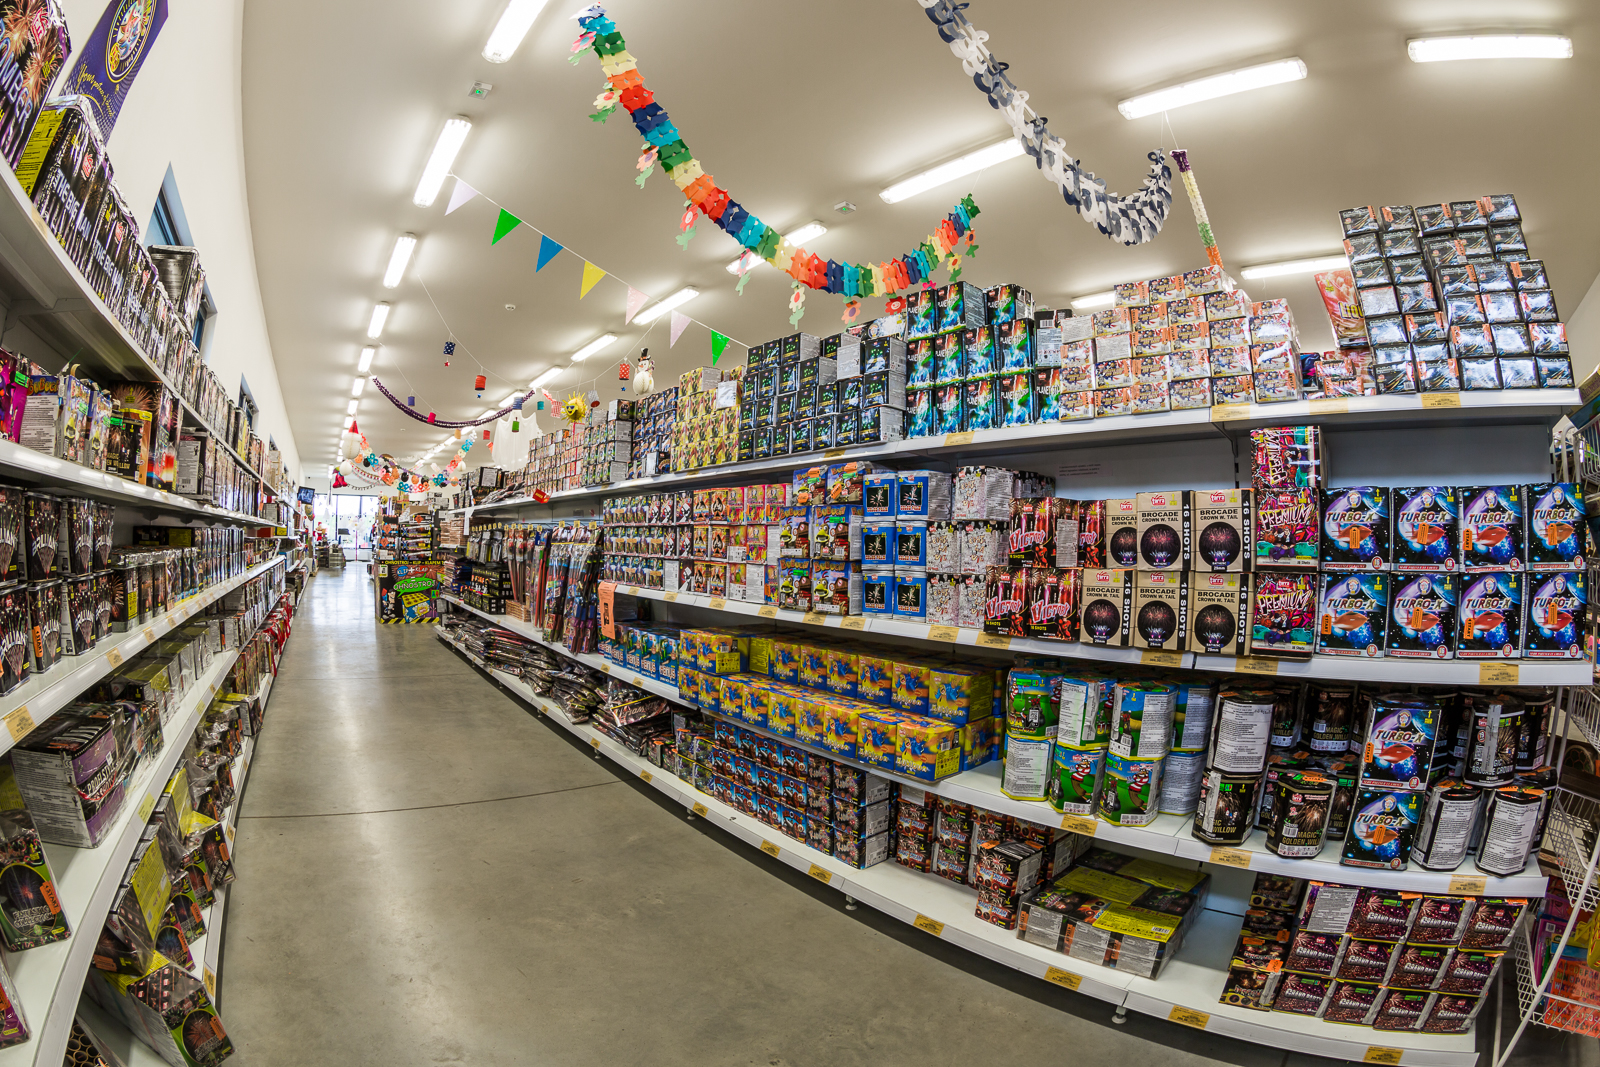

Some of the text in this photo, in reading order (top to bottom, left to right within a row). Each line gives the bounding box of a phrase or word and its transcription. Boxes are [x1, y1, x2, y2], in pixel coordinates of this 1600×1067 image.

[1000, 391, 1014, 399] PLANET
[1265, 428, 1287, 485] PREMIUM
[1183, 504, 1190, 517] 16
[1243, 501, 1250, 515] 16
[1534, 508, 1577, 520] TURBO-X
[1260, 503, 1314, 531] PREMIUM
[1326, 511, 1375, 522] TURBO-X
[1400, 511, 1448, 522] TURBO-X
[1468, 511, 1514, 524] TURBO-X
[1009, 528, 1046, 552] VICTORY
[985, 596, 1022, 618] VICTORY
[1122, 582, 1132, 635] 16 SHOTS
[1257, 590, 1312, 615] PREMIUM
[1327, 598, 1376, 609] TURBO-X
[1395, 598, 1446, 609] TURBO-X
[1465, 597, 1512, 609] TURBO-X
[1534, 597, 1577, 608] TURBO-X
[1031, 599, 1070, 623] VICTORY
[1178, 582, 1188, 638] 16 SHOTS
[1237, 586, 1247, 643] 16 SHOTS
[1375, 729, 1425, 743] TURBO-X
[1356, 813, 1407, 827] TURBO-X
[1213, 826, 1237, 834] WILLOW
[1282, 837, 1306, 845] GOLDEN
[979, 867, 1008, 885] MAGIC DREAM
[46, 887, 59, 909] START
[978, 900, 1008, 918] MAGIC DREAM
